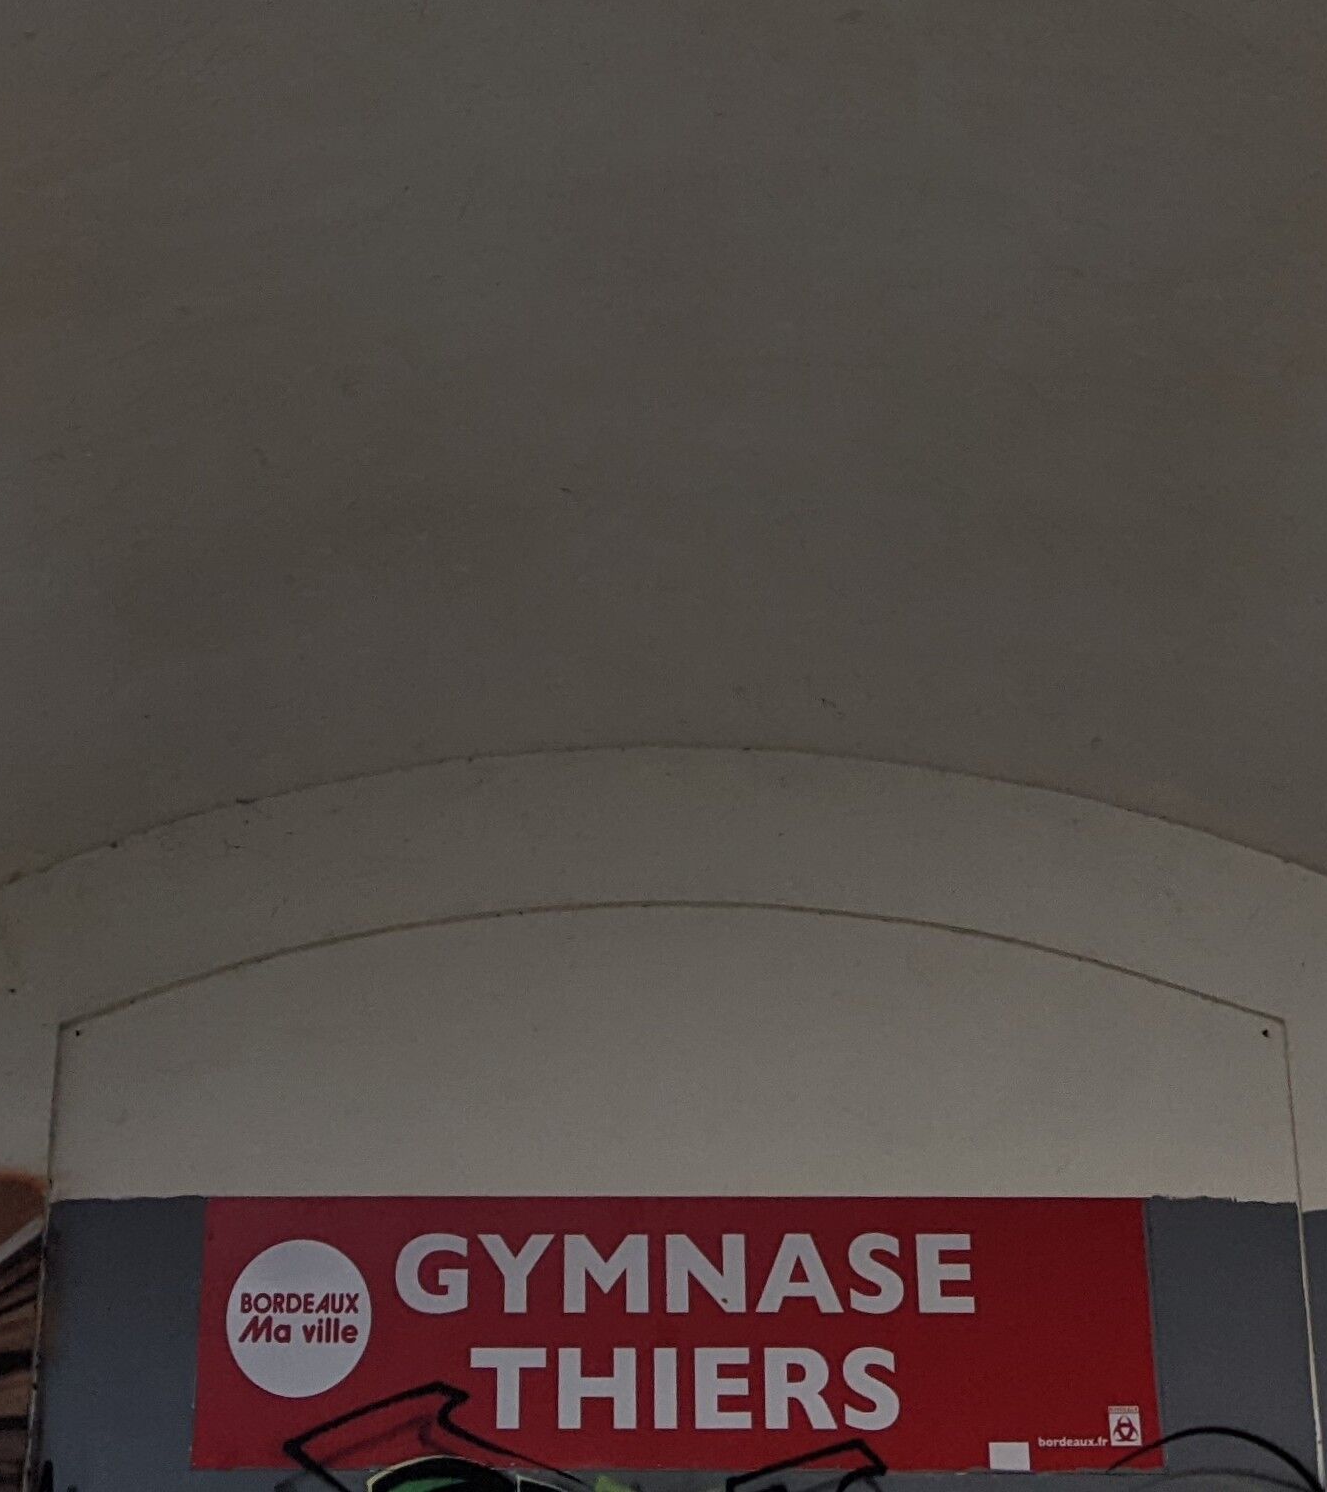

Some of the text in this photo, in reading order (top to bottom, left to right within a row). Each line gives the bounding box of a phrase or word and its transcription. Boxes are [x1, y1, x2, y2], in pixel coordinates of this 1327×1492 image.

[394, 1232, 976, 1315] GYMNASE
[239, 1292, 360, 1314] BORDEAUX
[237, 1315, 359, 1344] Ma ville
[470, 1346, 902, 1430] THIERS
[1037, 1436, 1108, 1447] bordeaux.fr
